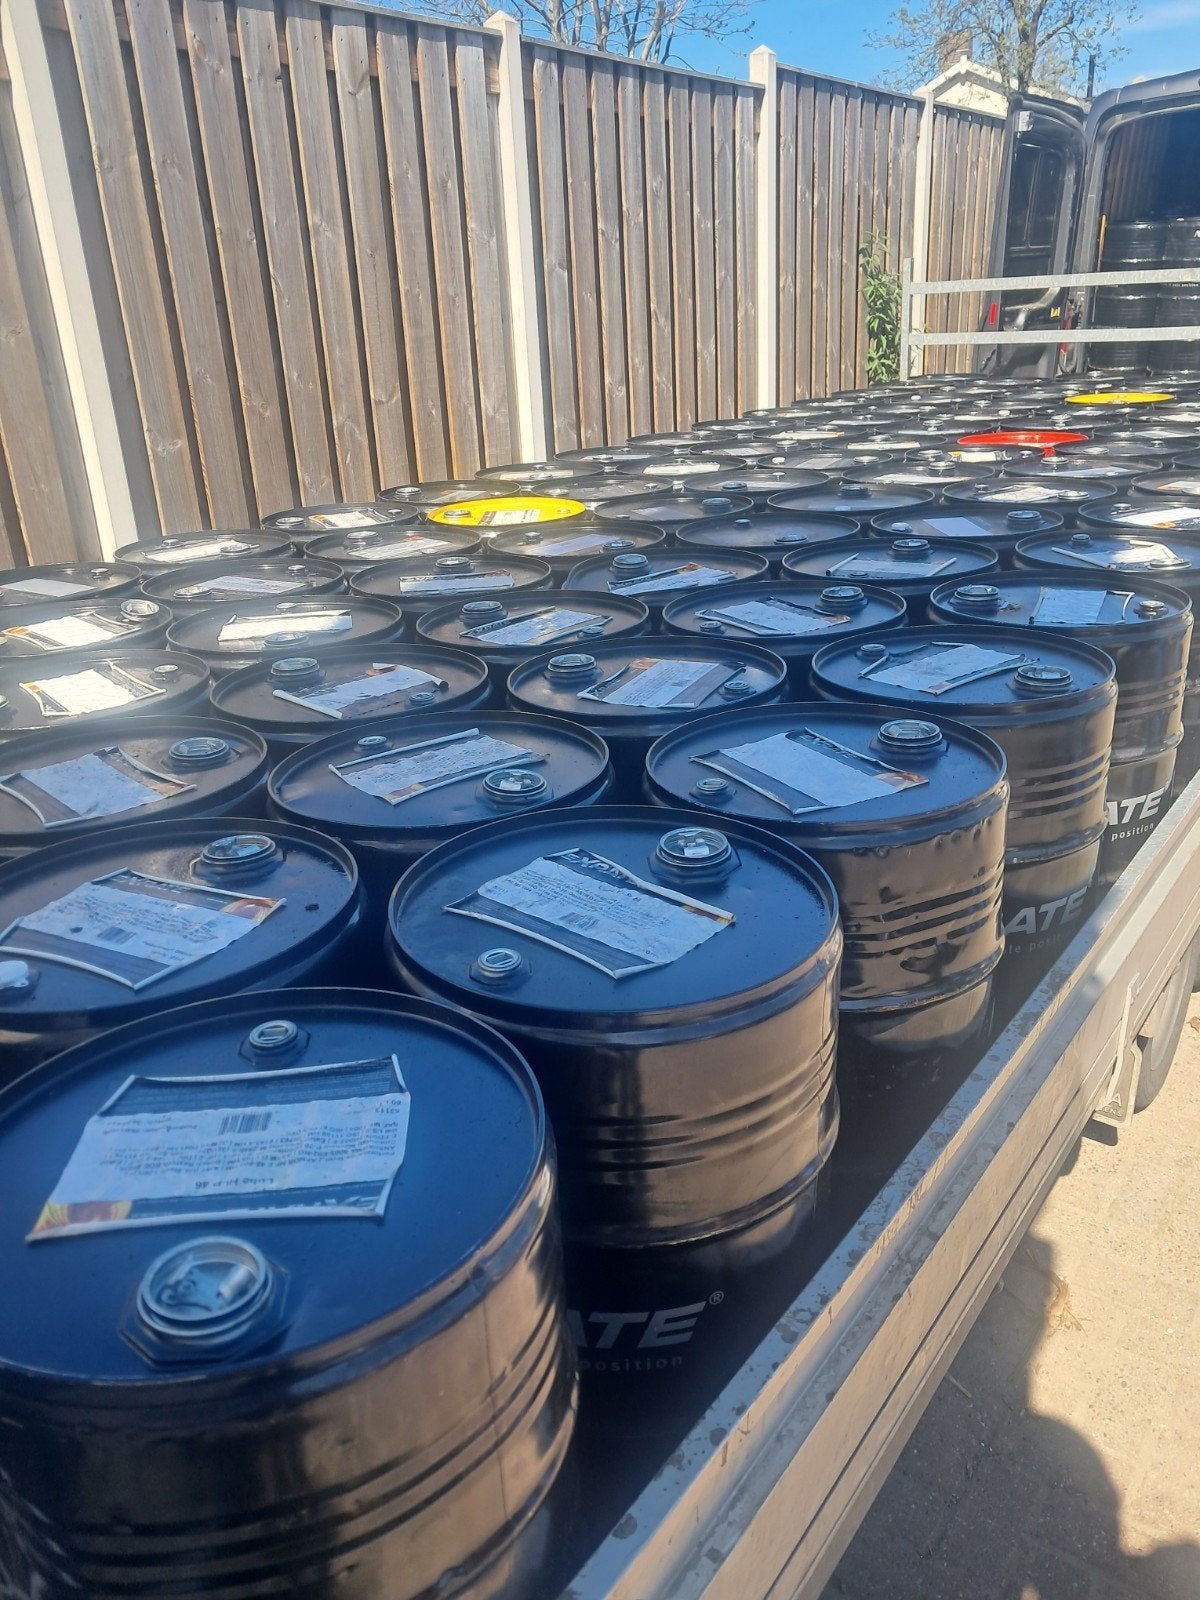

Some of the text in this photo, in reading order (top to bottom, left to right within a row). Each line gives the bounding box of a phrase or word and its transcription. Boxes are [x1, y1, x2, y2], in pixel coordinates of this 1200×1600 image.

[1111, 823, 1154, 842] position
[1004, 885, 1088, 935] ATE
[581, 1356, 683, 1372] position
